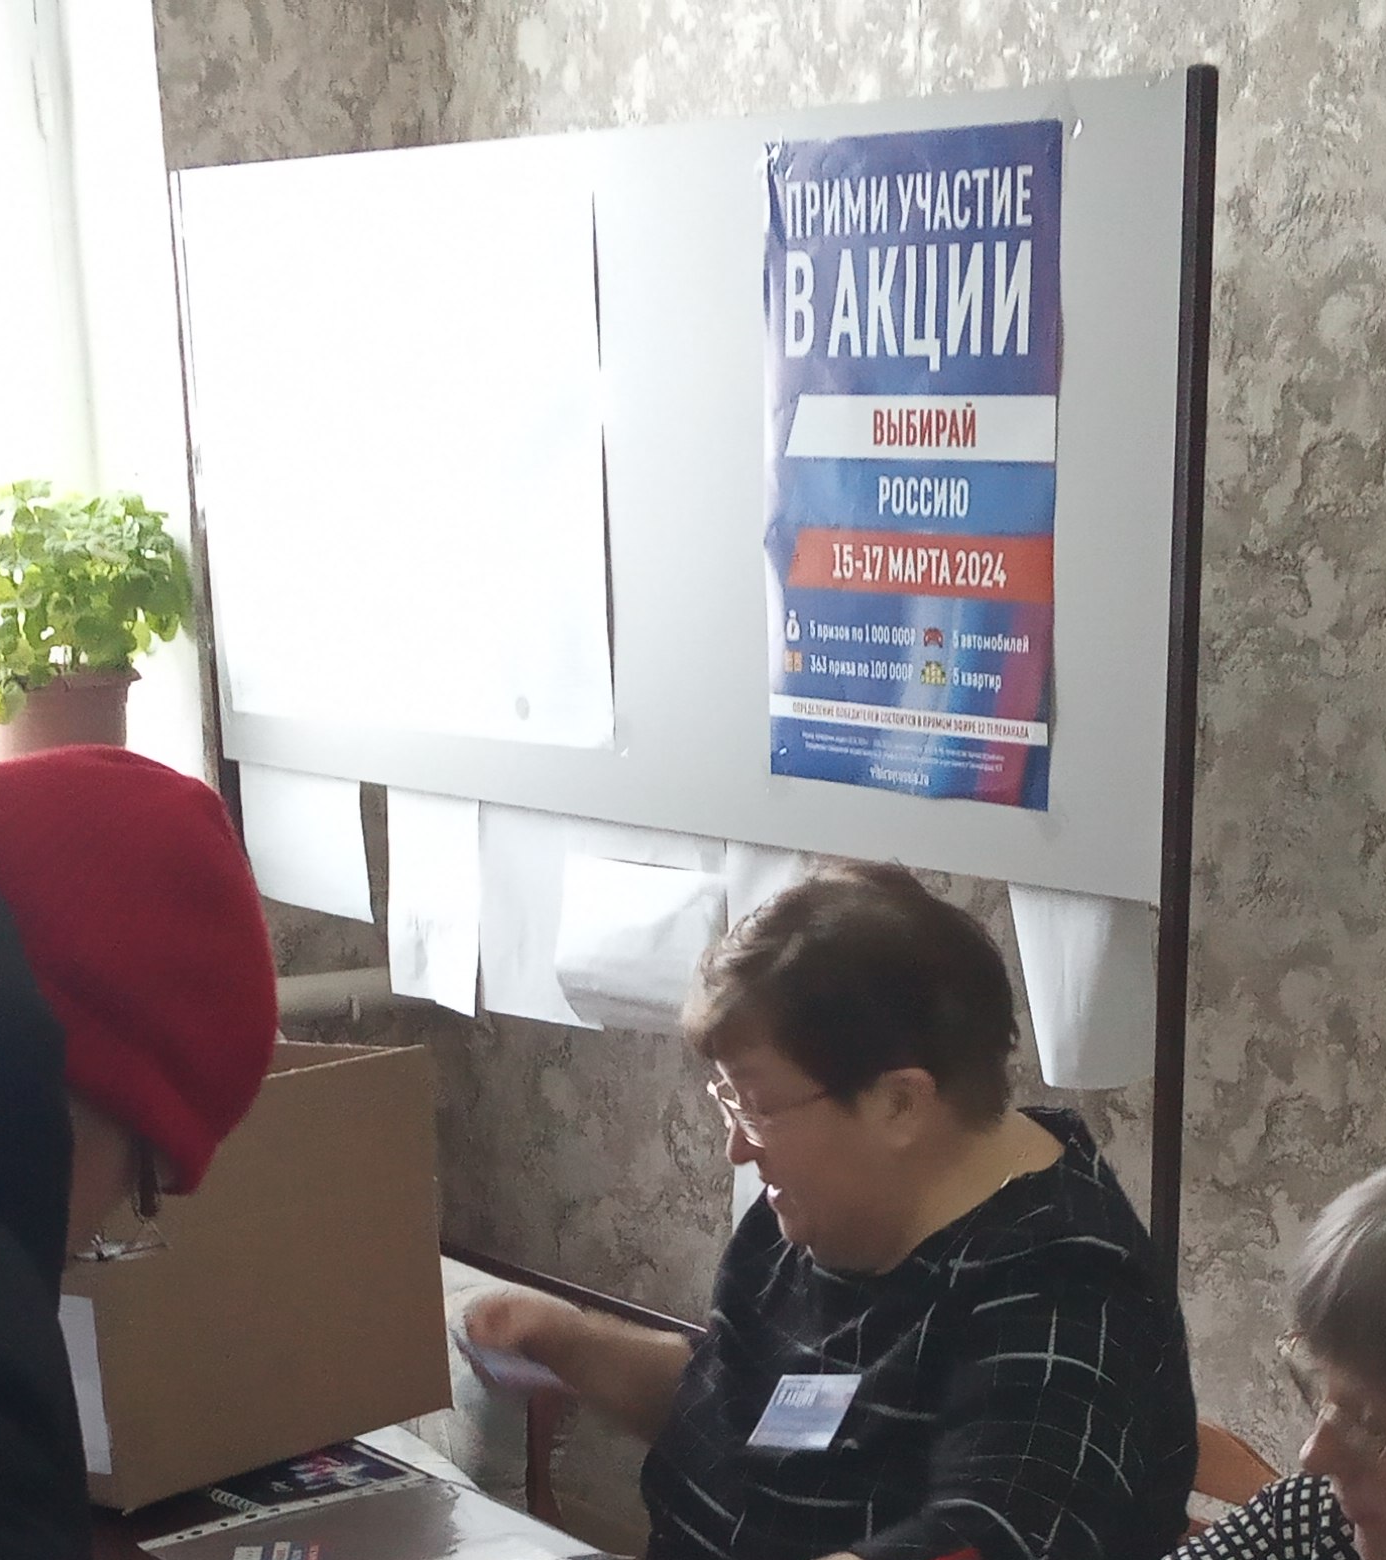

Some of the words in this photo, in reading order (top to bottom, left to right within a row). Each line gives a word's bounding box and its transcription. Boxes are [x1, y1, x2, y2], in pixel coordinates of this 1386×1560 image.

[785, 176, 888, 239] ПРИМИ
[896, 165, 1033, 233] УЧАСТИЕ
[784, 250, 815, 358] В
[827, 240, 1032, 372] АКЦИИ
[873, 402, 977, 448] ВЫБИРАЙ
[878, 476, 970, 518] РОССИЮ
[832, 543, 884, 581] 15-17
[888, 546, 952, 587] МАРТА
[955, 551, 1008, 588] 2024
[817, 624, 850, 643] призов
[852, 626, 864, 642] по
[961, 633, 1029, 653] автомобилей
[857, 662, 870, 677] по
[960, 671, 1002, 693] квартир
